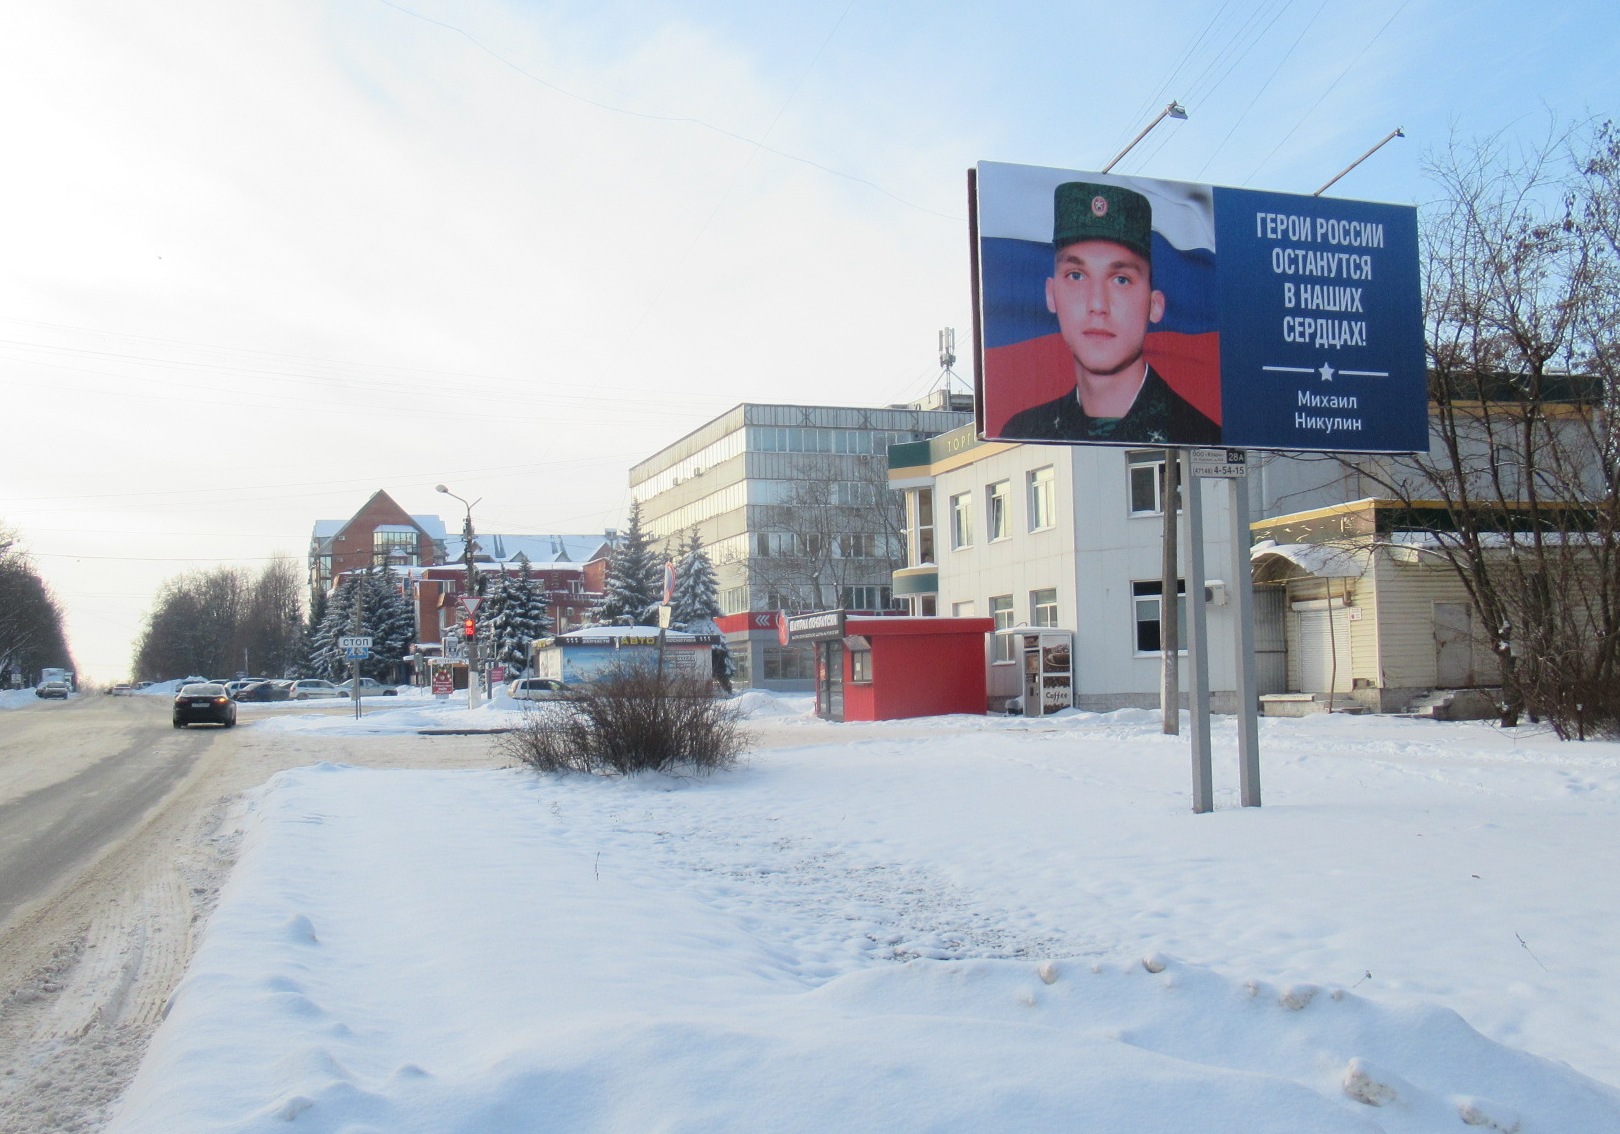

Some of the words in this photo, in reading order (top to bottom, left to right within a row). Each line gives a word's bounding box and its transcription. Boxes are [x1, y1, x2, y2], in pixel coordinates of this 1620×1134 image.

[1256, 212, 1312, 242] ГЕРОИ
[1316, 218, 1384, 248] РОССИИ
[1272, 247, 1372, 280] ОСТАНУТСЯ
[1284, 282, 1296, 308] В
[1300, 283, 1364, 313] НАШИХ
[1283, 316, 1367, 350] СЕРДЦАХ!
[1298, 390, 1357, 409] Михаил
[1295, 411, 1362, 434] Никулин
[947, 433, 972, 453] ТОРГ
[1228, 453, 1244, 462] 28А
[1214, 466, 1245, 475] 4-54-15
[621, 637, 656, 645] АВТО
[1045, 691, 1068, 702] Coffee
